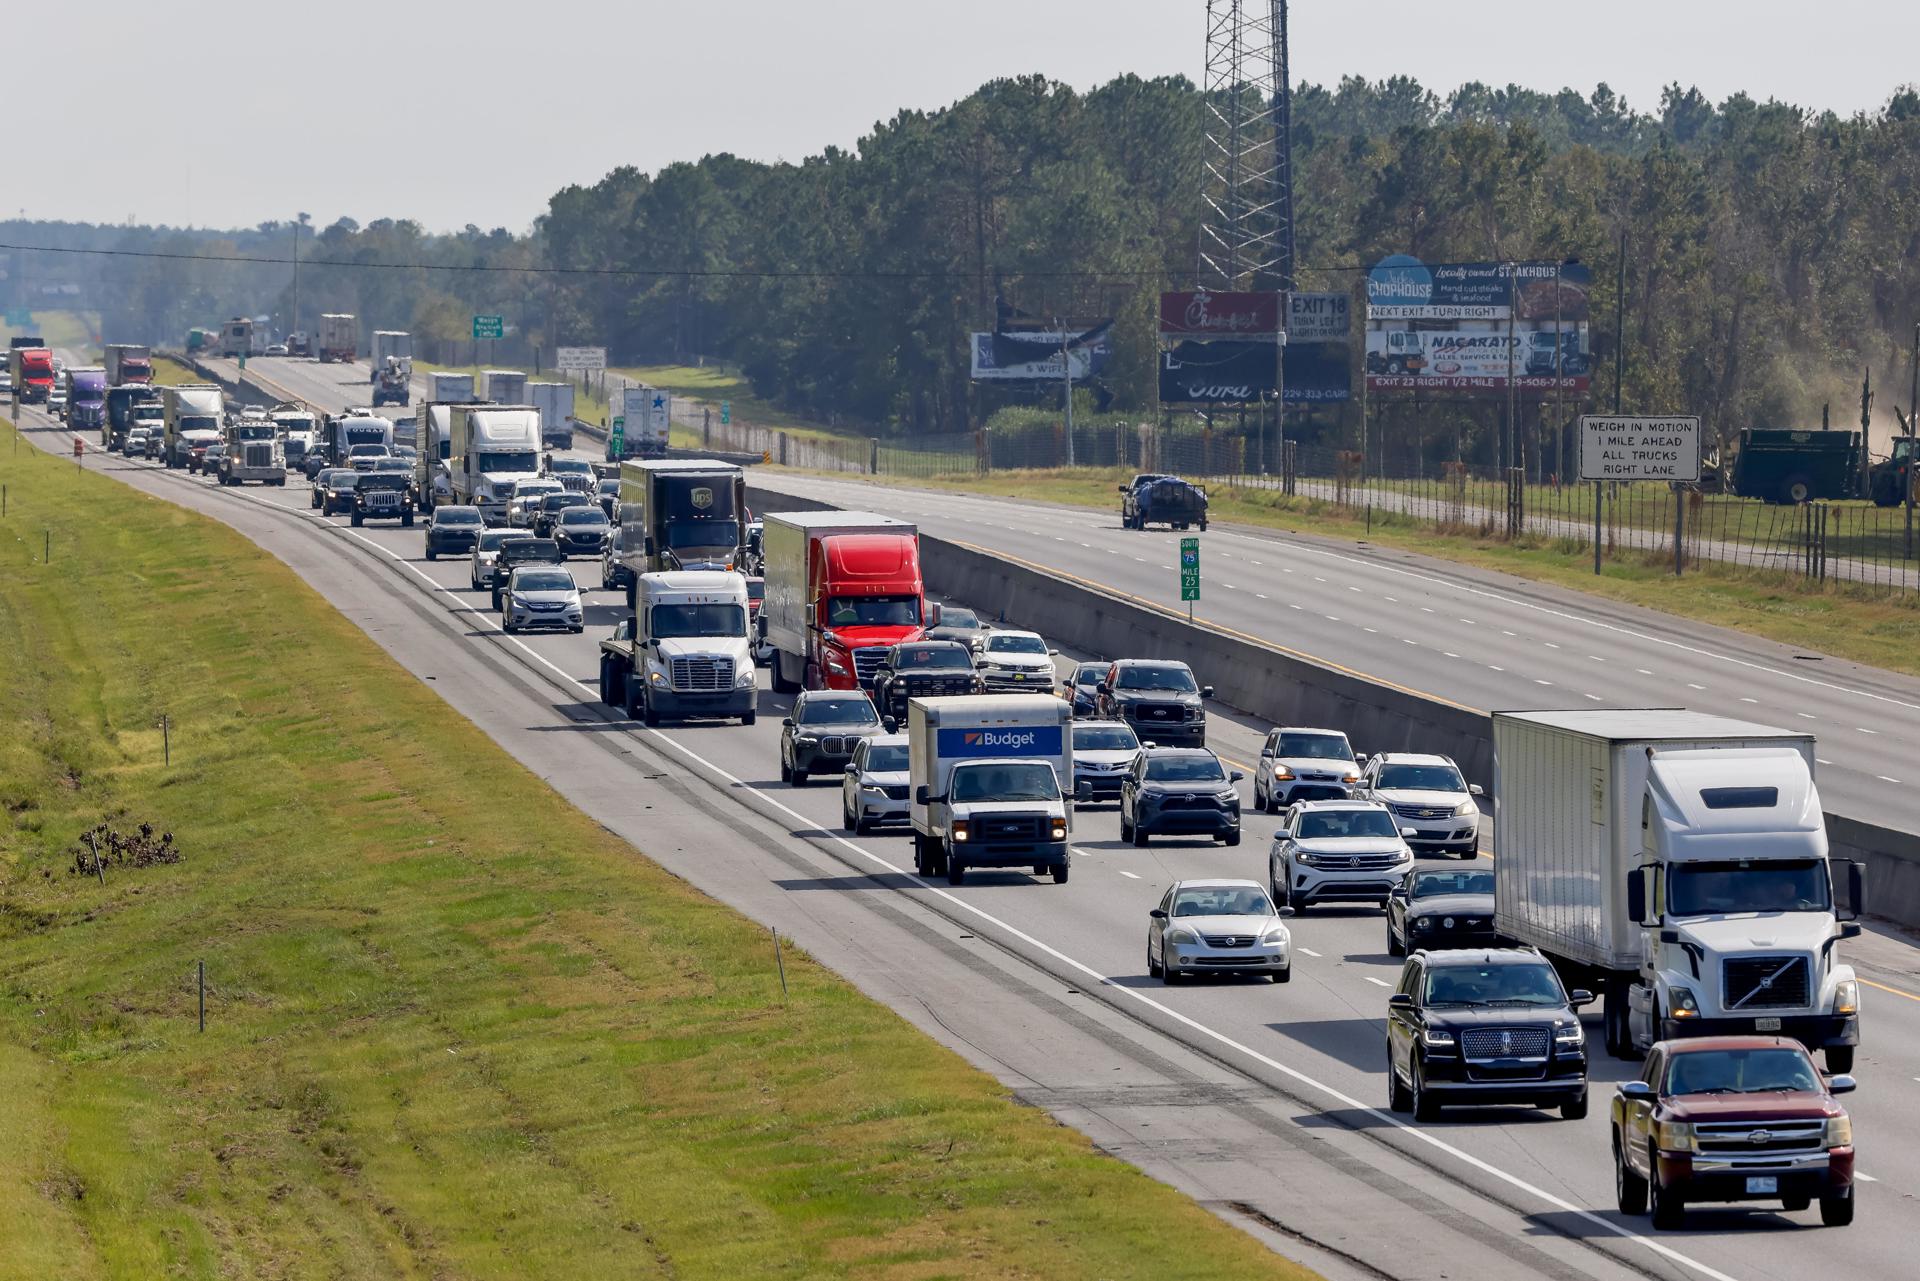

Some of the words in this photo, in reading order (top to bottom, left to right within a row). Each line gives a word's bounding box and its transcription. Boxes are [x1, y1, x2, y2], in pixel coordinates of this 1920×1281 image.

[1435, 266, 1467, 280] Locally
[1498, 265, 1560, 278] STAKHOUS
[1368, 283, 1433, 298] CHOPHOUSE
[1440, 285, 1462, 293] Hand
[1292, 297, 1326, 313] EXIT
[1371, 306, 1399, 317] NEXT
[1402, 306, 1425, 317] EXIT
[1432, 307, 1461, 317] TURN
[1464, 307, 1496, 317] RIGHT
[1294, 316, 1315, 326] TURN
[1320, 316, 1342, 327] LEFT
[1375, 378, 1399, 386] EXIT
[1403, 378, 1415, 387] 22
[1417, 378, 1448, 387] RIGHT
[1452, 378, 1467, 387] 1/2
[1470, 378, 1495, 387] MILE
[1589, 422, 1625, 431] WEIGH
[1630, 423, 1642, 431] IN
[1648, 423, 1692, 432] MOTION
[1608, 436, 1635, 446] MILE
[1641, 437, 1682, 446] AHEAD
[1602, 451, 1625, 460] ALL
[1632, 451, 1678, 460] TRUCKS
[1603, 464, 1637, 474] RIGHT
[1644, 465, 1676, 475] LANE
[693, 493, 711, 506] ups
[1181, 539, 1199, 548] SOUTH
[1184, 554, 1195, 562] 75
[1182, 567, 1198, 576] MILE
[1185, 576, 1196, 587] 25
[984, 732, 1035, 748] Budget
